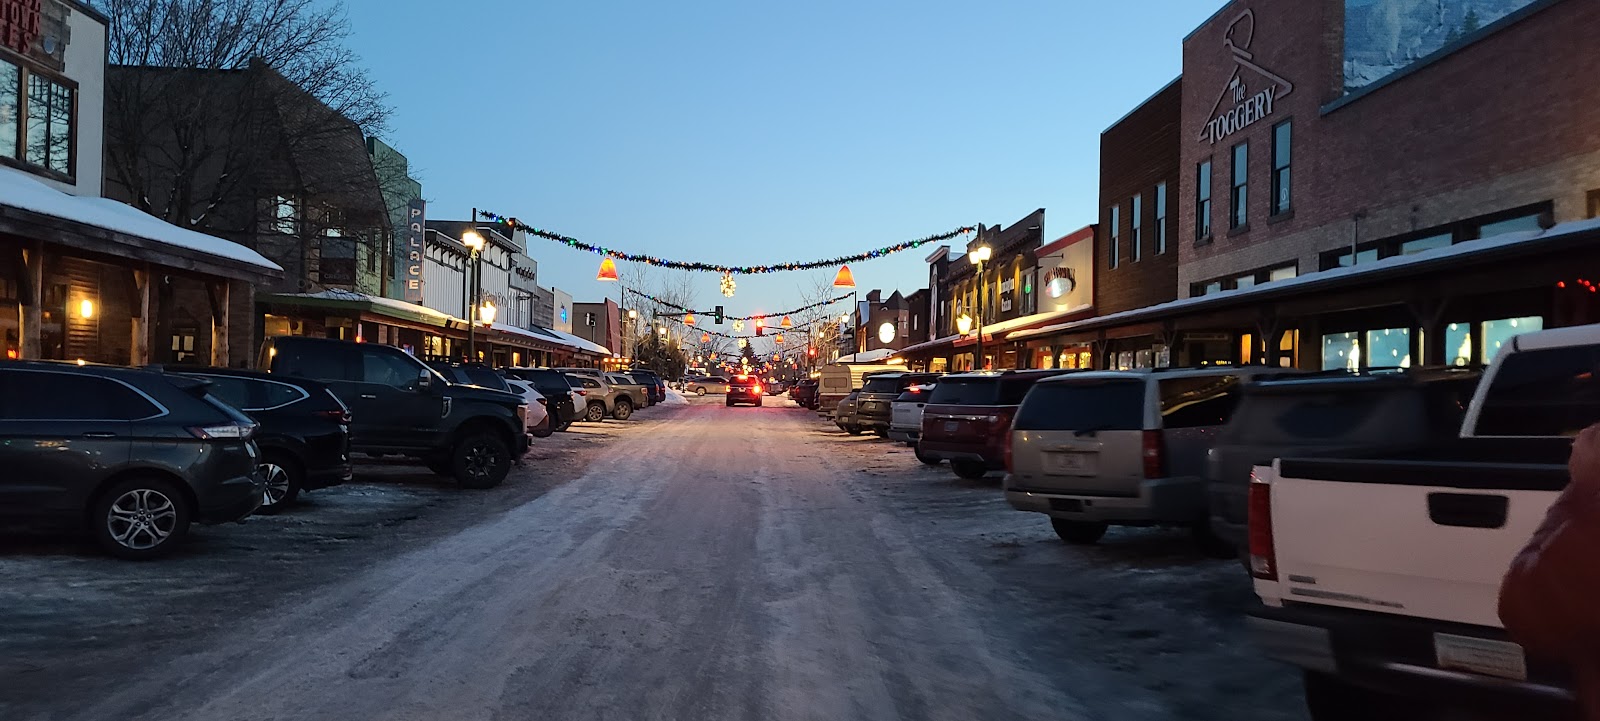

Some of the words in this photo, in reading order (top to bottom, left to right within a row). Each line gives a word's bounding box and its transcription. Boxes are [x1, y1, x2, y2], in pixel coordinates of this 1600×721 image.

[1208, 84, 1277, 145] TOGGERY
[1230, 75, 1246, 103] The
[409, 208, 421, 290] PALACE
